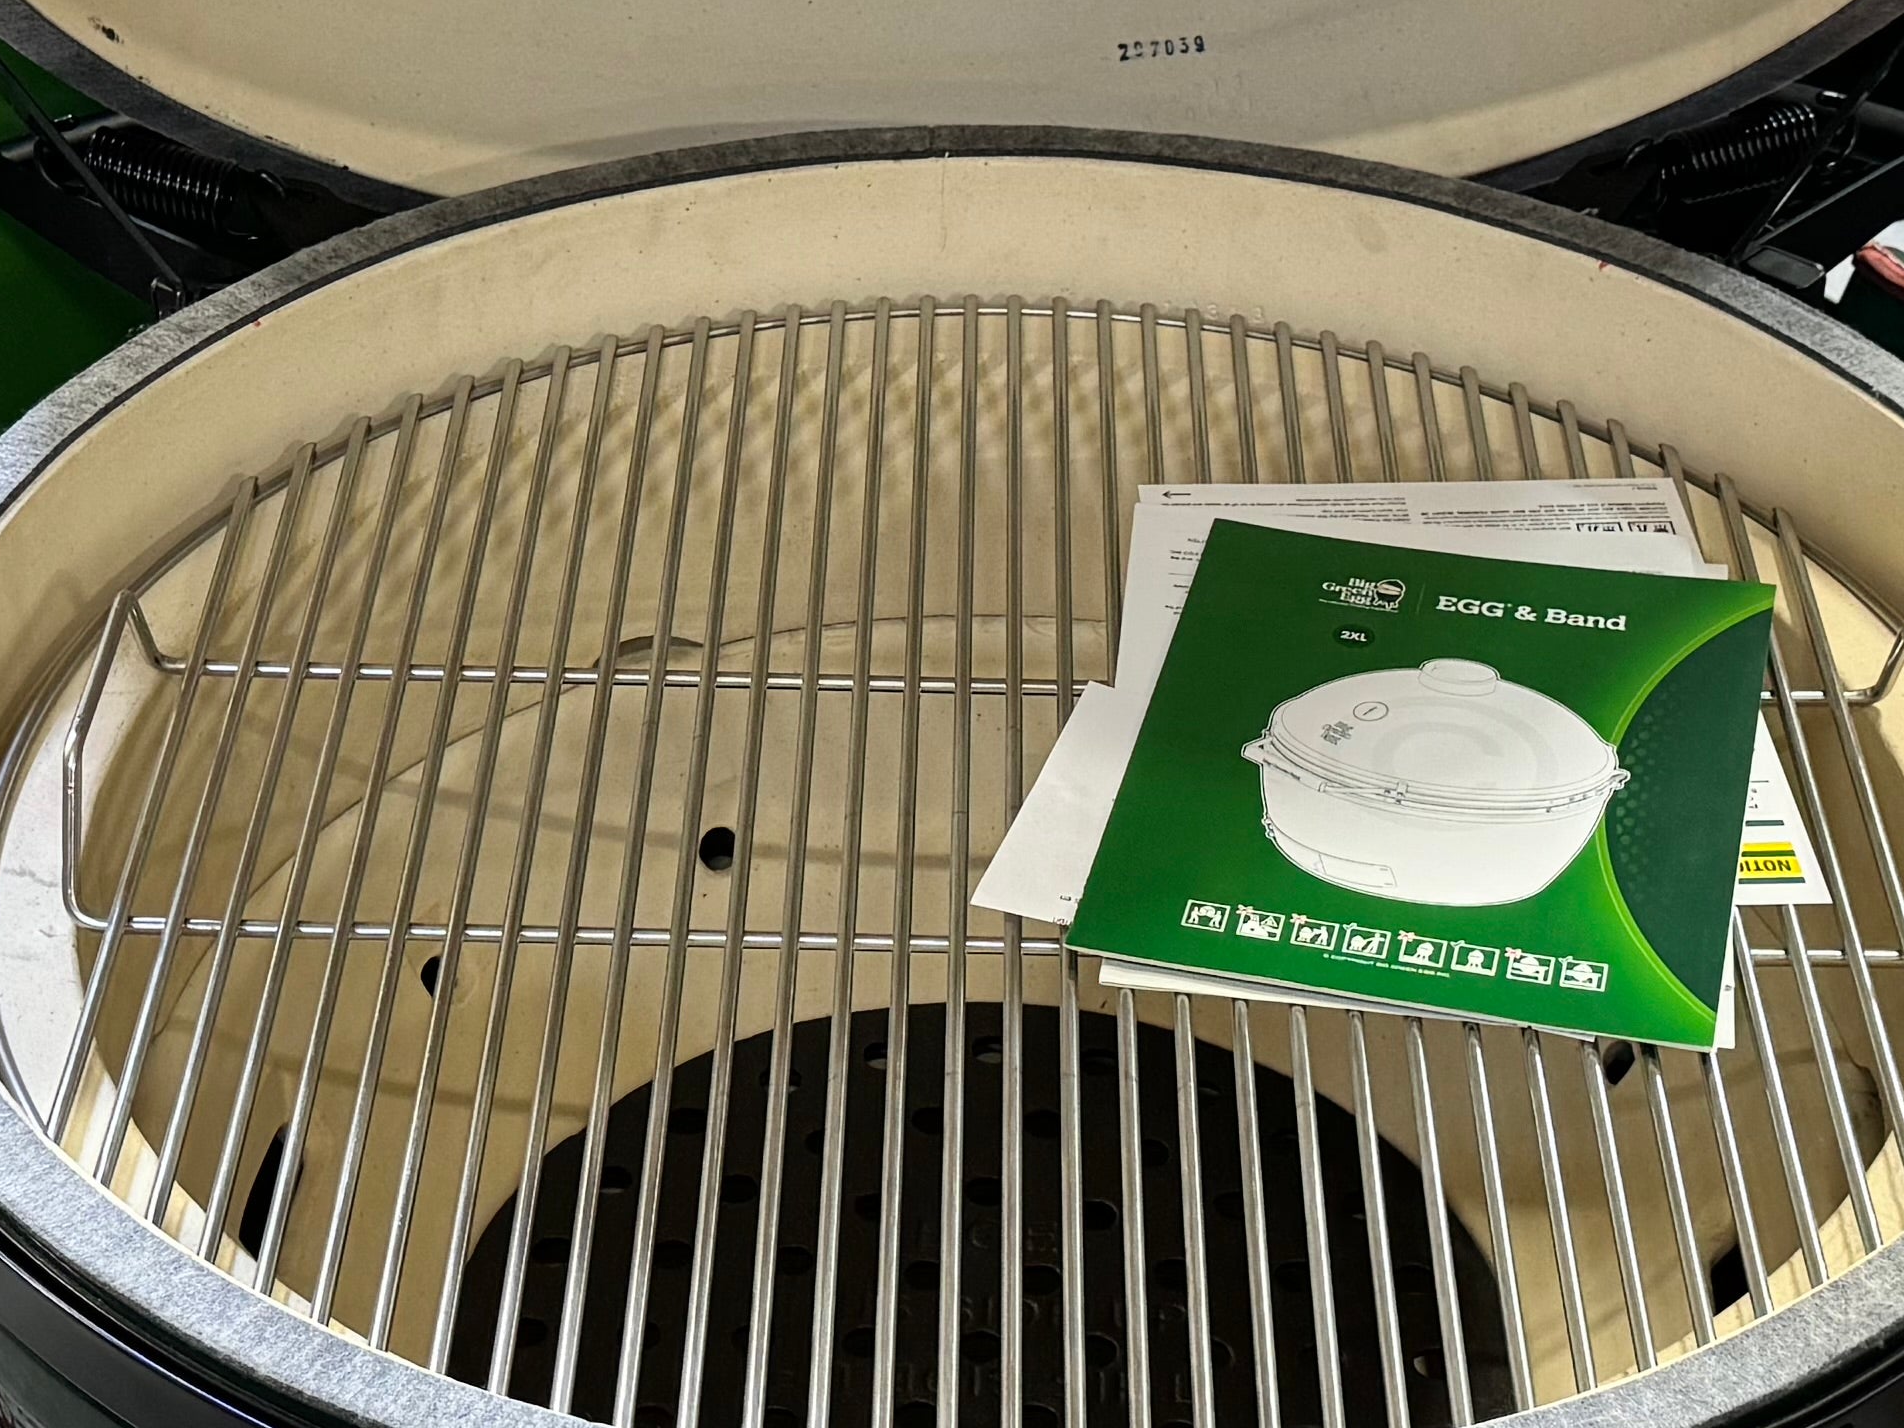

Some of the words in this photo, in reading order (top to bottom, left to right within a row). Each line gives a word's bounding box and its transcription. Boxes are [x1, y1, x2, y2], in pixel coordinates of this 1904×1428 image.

[1436, 595, 1506, 618] EGG
[1514, 606, 1537, 622] &
[1544, 608, 1626, 631] Band
[1340, 630, 1367, 642] 2XL
[1740, 859, 1791, 872] NOTI
